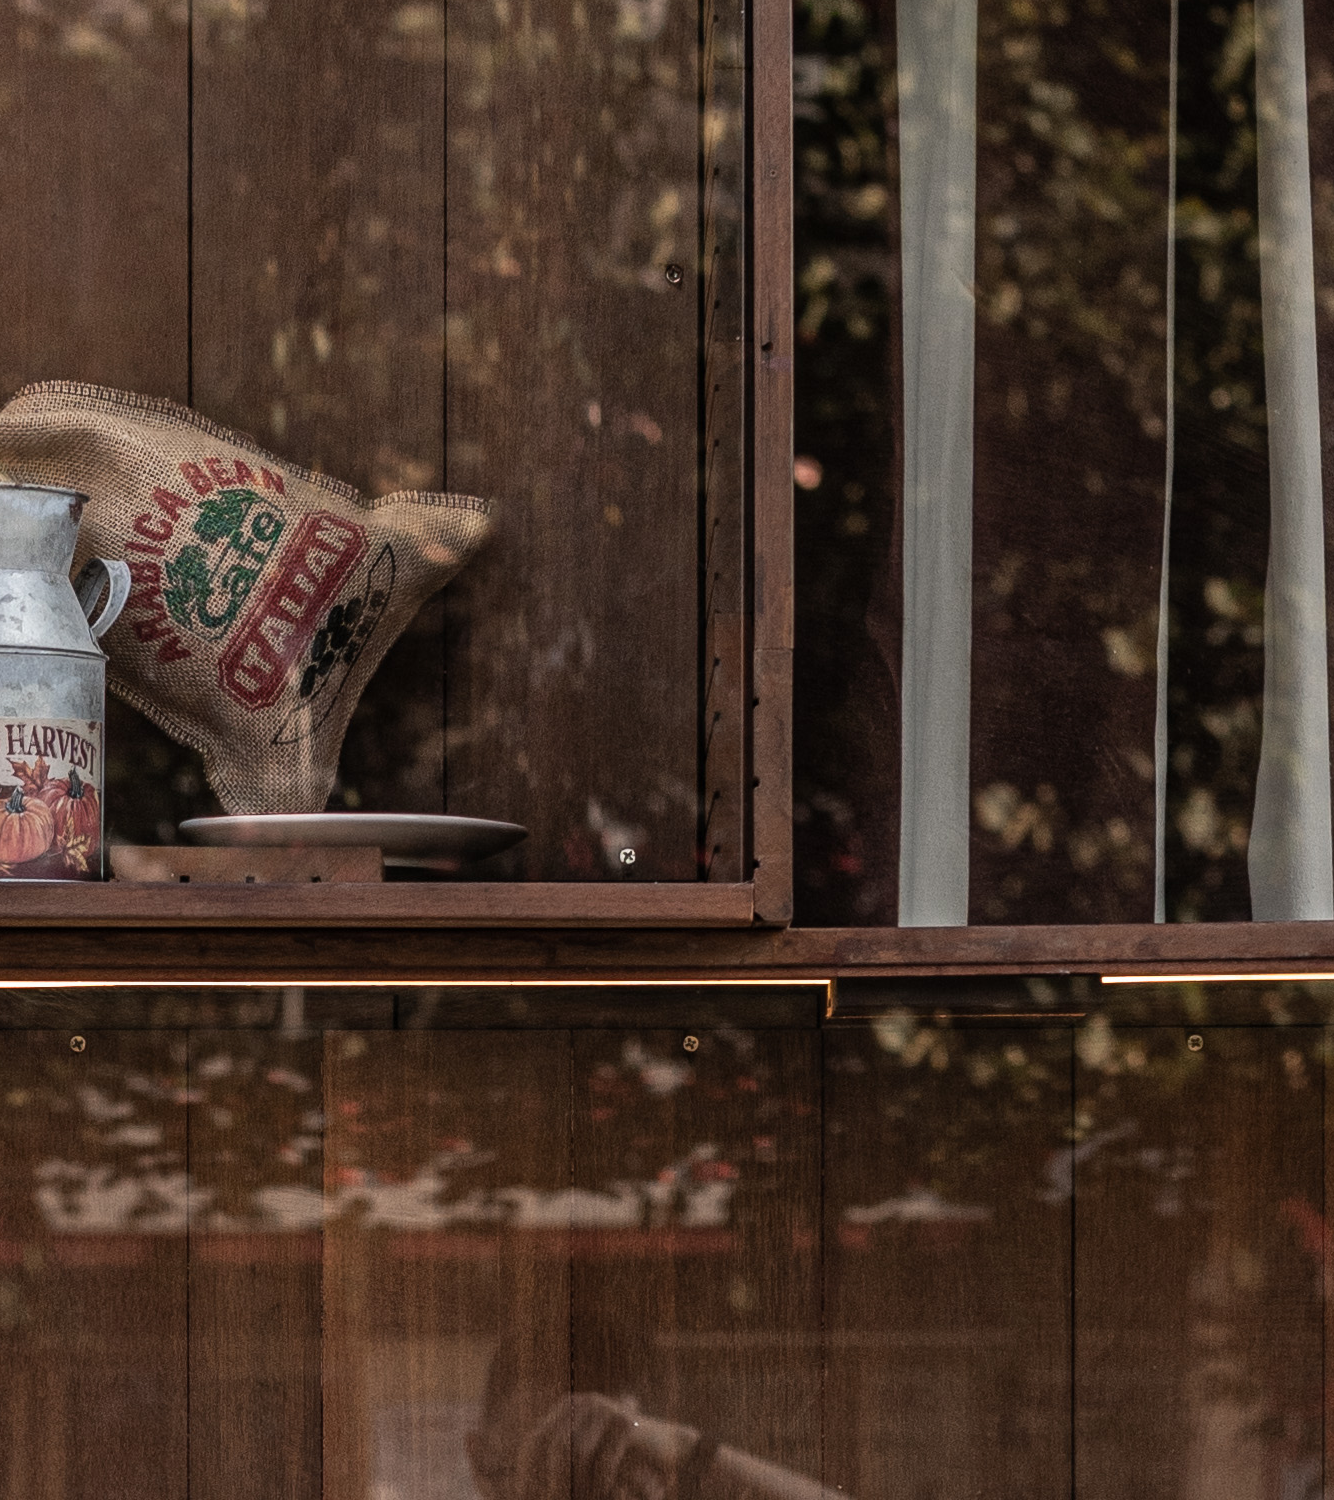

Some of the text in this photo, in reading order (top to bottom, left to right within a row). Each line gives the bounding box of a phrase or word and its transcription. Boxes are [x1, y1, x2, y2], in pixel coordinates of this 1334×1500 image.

[124, 456, 287, 665] ARABICA BEAN
[233, 518, 356, 693] ITALIAN
[4, 723, 97, 776] HARVEST
